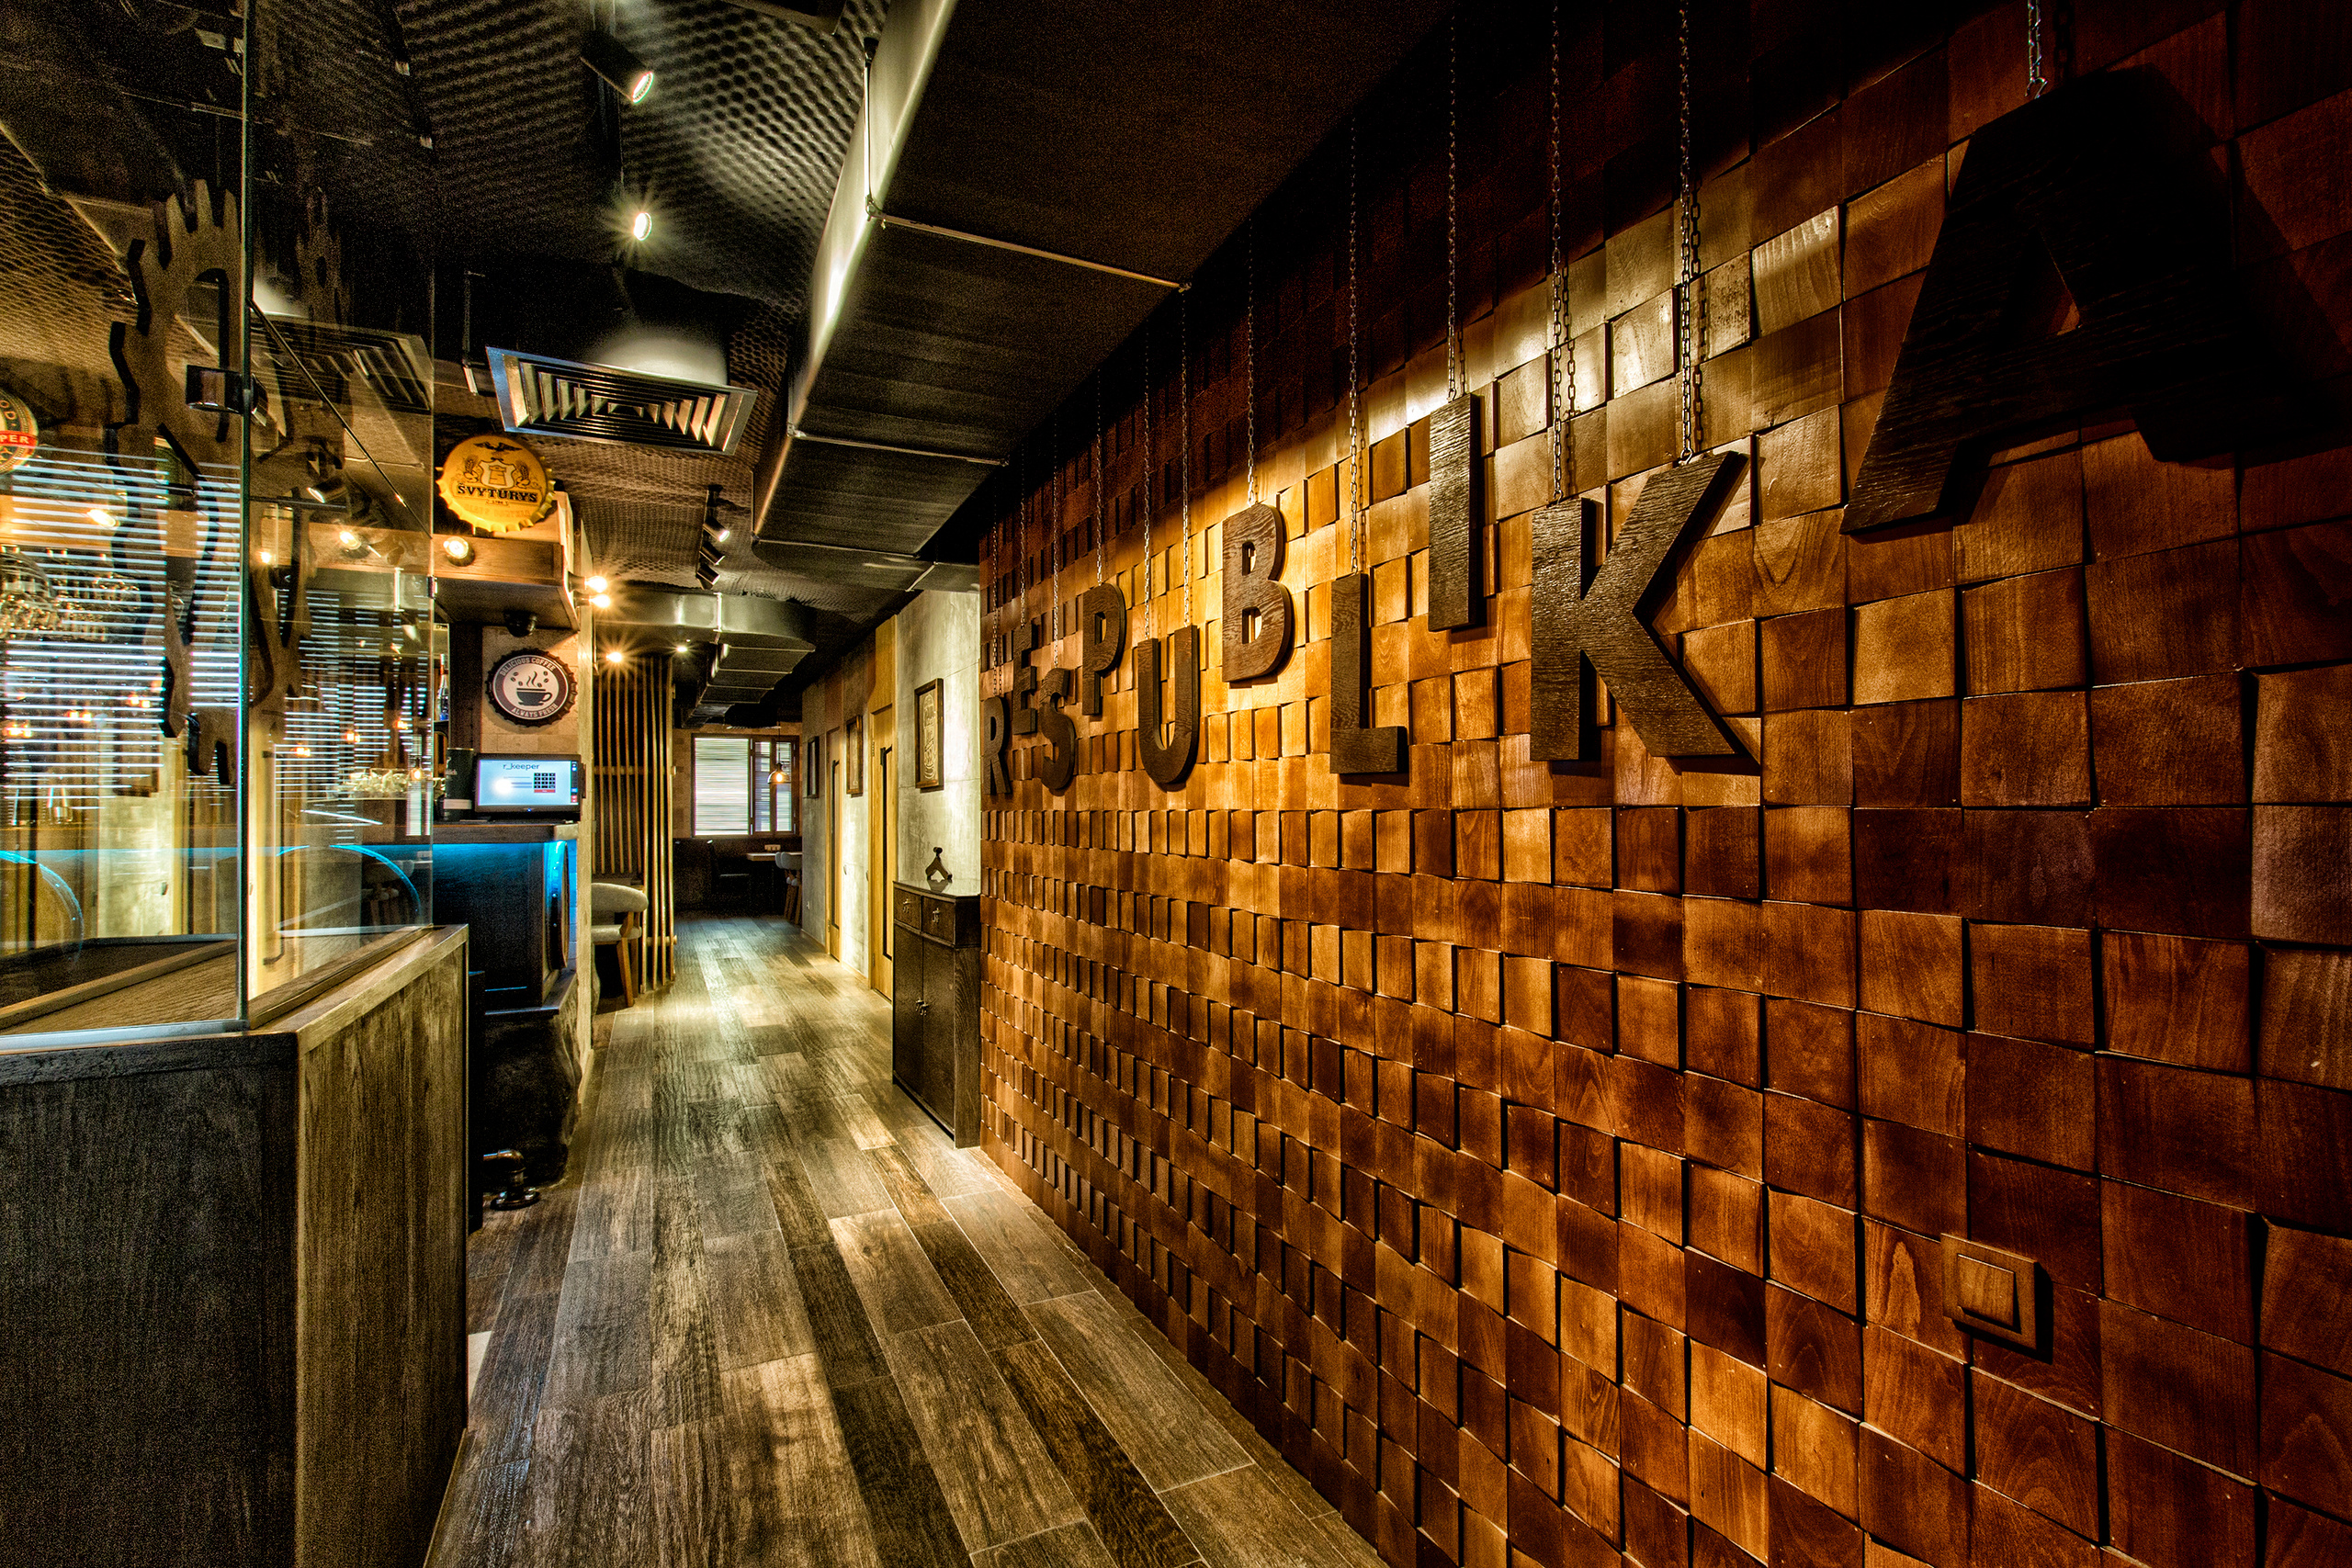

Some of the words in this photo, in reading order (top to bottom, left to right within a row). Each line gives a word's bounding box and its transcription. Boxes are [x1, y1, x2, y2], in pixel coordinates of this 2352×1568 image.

[982, 65, 2335, 795] RESPUBLIKA
[458, 482, 537, 502] ŠVYTURYS
[500, 658, 530, 676] DELICIOUS
[532, 658, 556, 671] COFFEE
[511, 707, 537, 717] ALWAYS
[538, 703, 558, 716] FRESH
[503, 762, 540, 771] r_keeper
